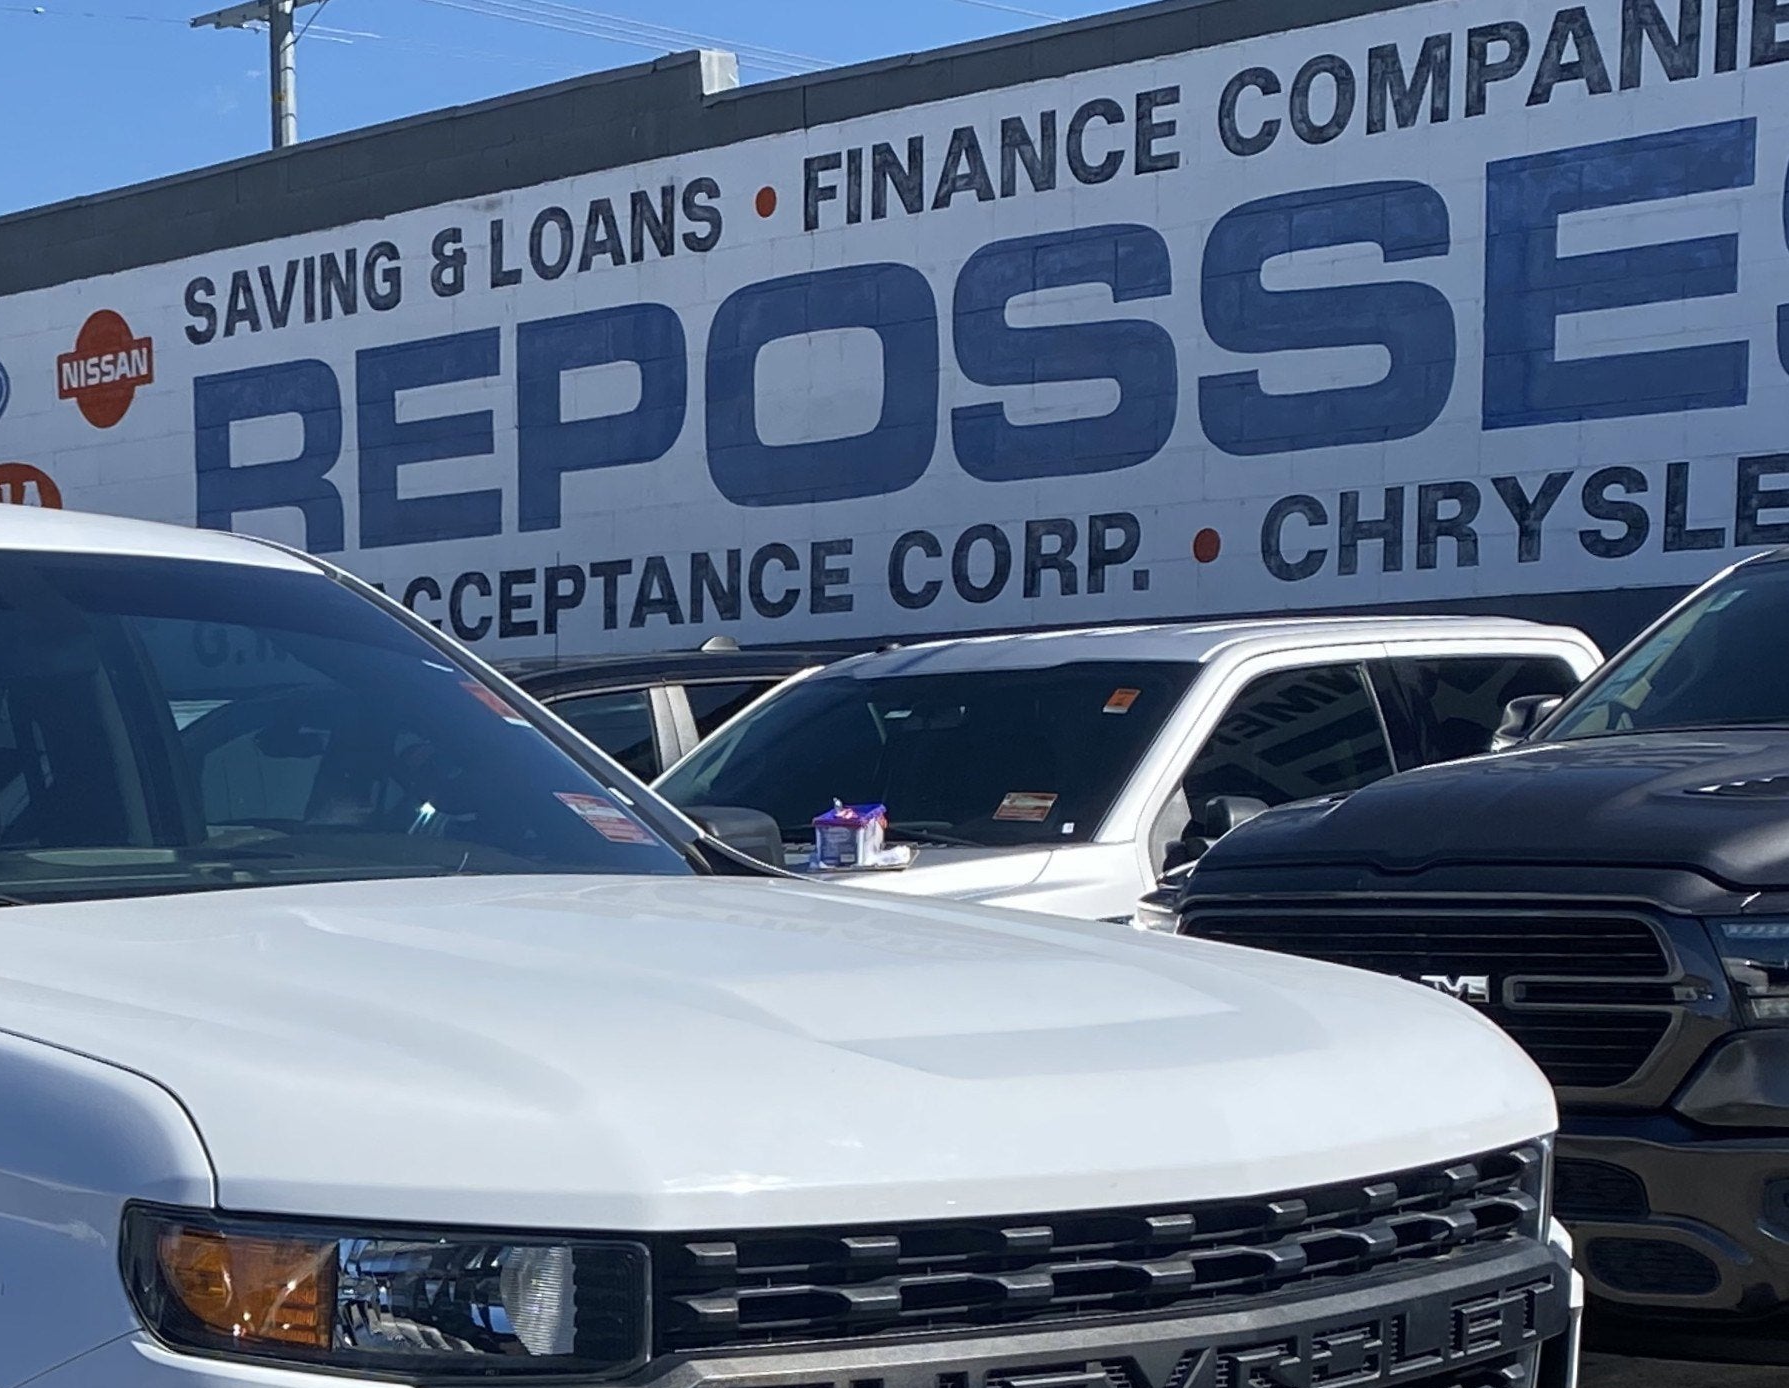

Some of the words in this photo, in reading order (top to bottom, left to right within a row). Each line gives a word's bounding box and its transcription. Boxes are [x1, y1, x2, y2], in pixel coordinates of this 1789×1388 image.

[184, 241, 402, 345] SAVING
[429, 226, 468, 298] &
[489, 176, 722, 290] LOANS
[803, 84, 1182, 233] FINANCE
[62, 347, 149, 391] NISSAN
[193, 116, 1789, 553] REPOSSE
[375, 538, 854, 642] CCEPTANCE
[888, 511, 1151, 611] CORP.
